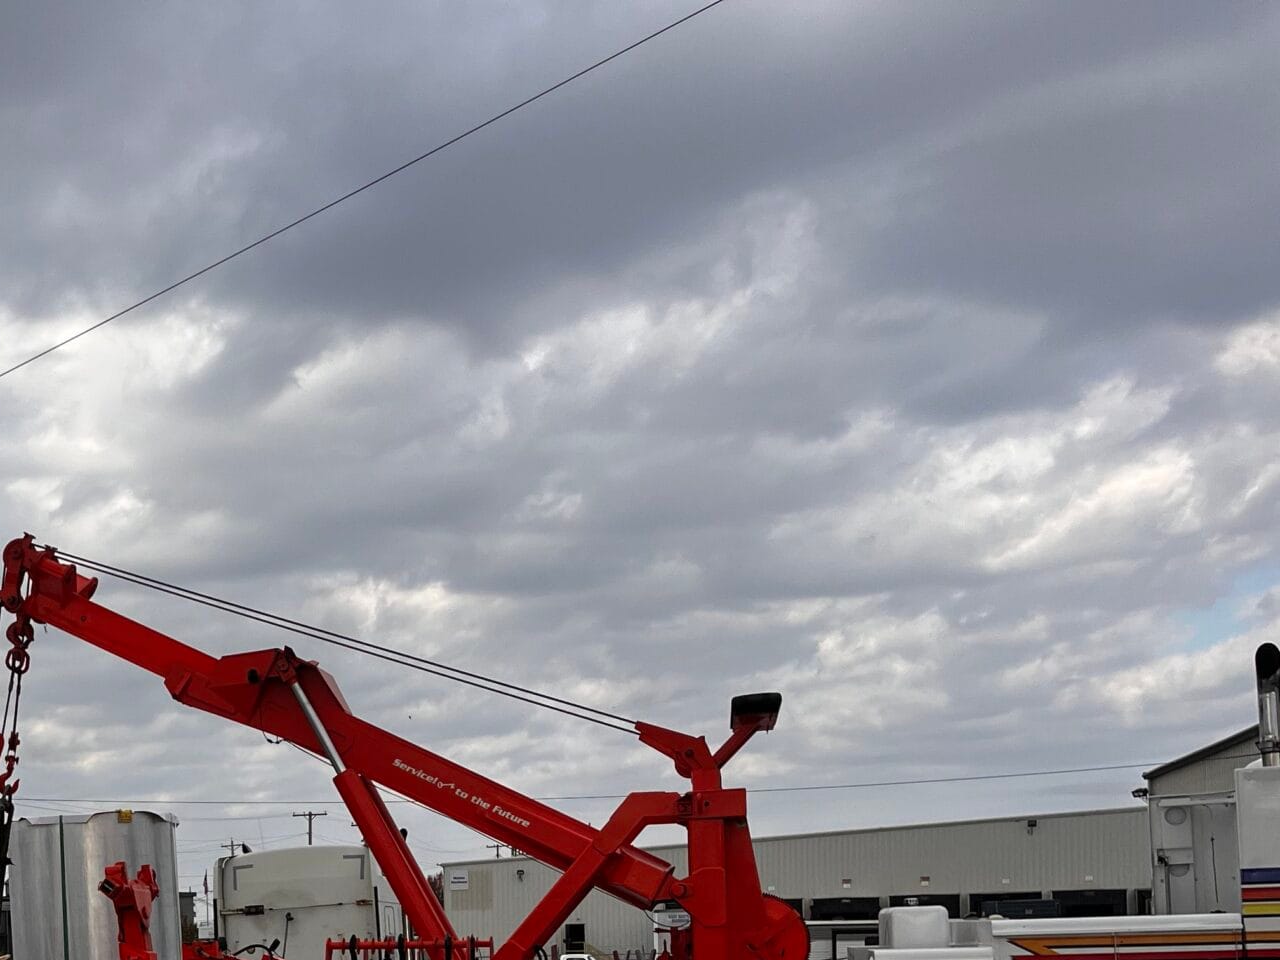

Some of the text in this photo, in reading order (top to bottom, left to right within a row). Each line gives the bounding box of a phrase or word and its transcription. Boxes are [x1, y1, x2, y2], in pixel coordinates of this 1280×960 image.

[455, 788, 469, 799] to
[471, 795, 491, 810] the
[492, 804, 531, 828] Future
